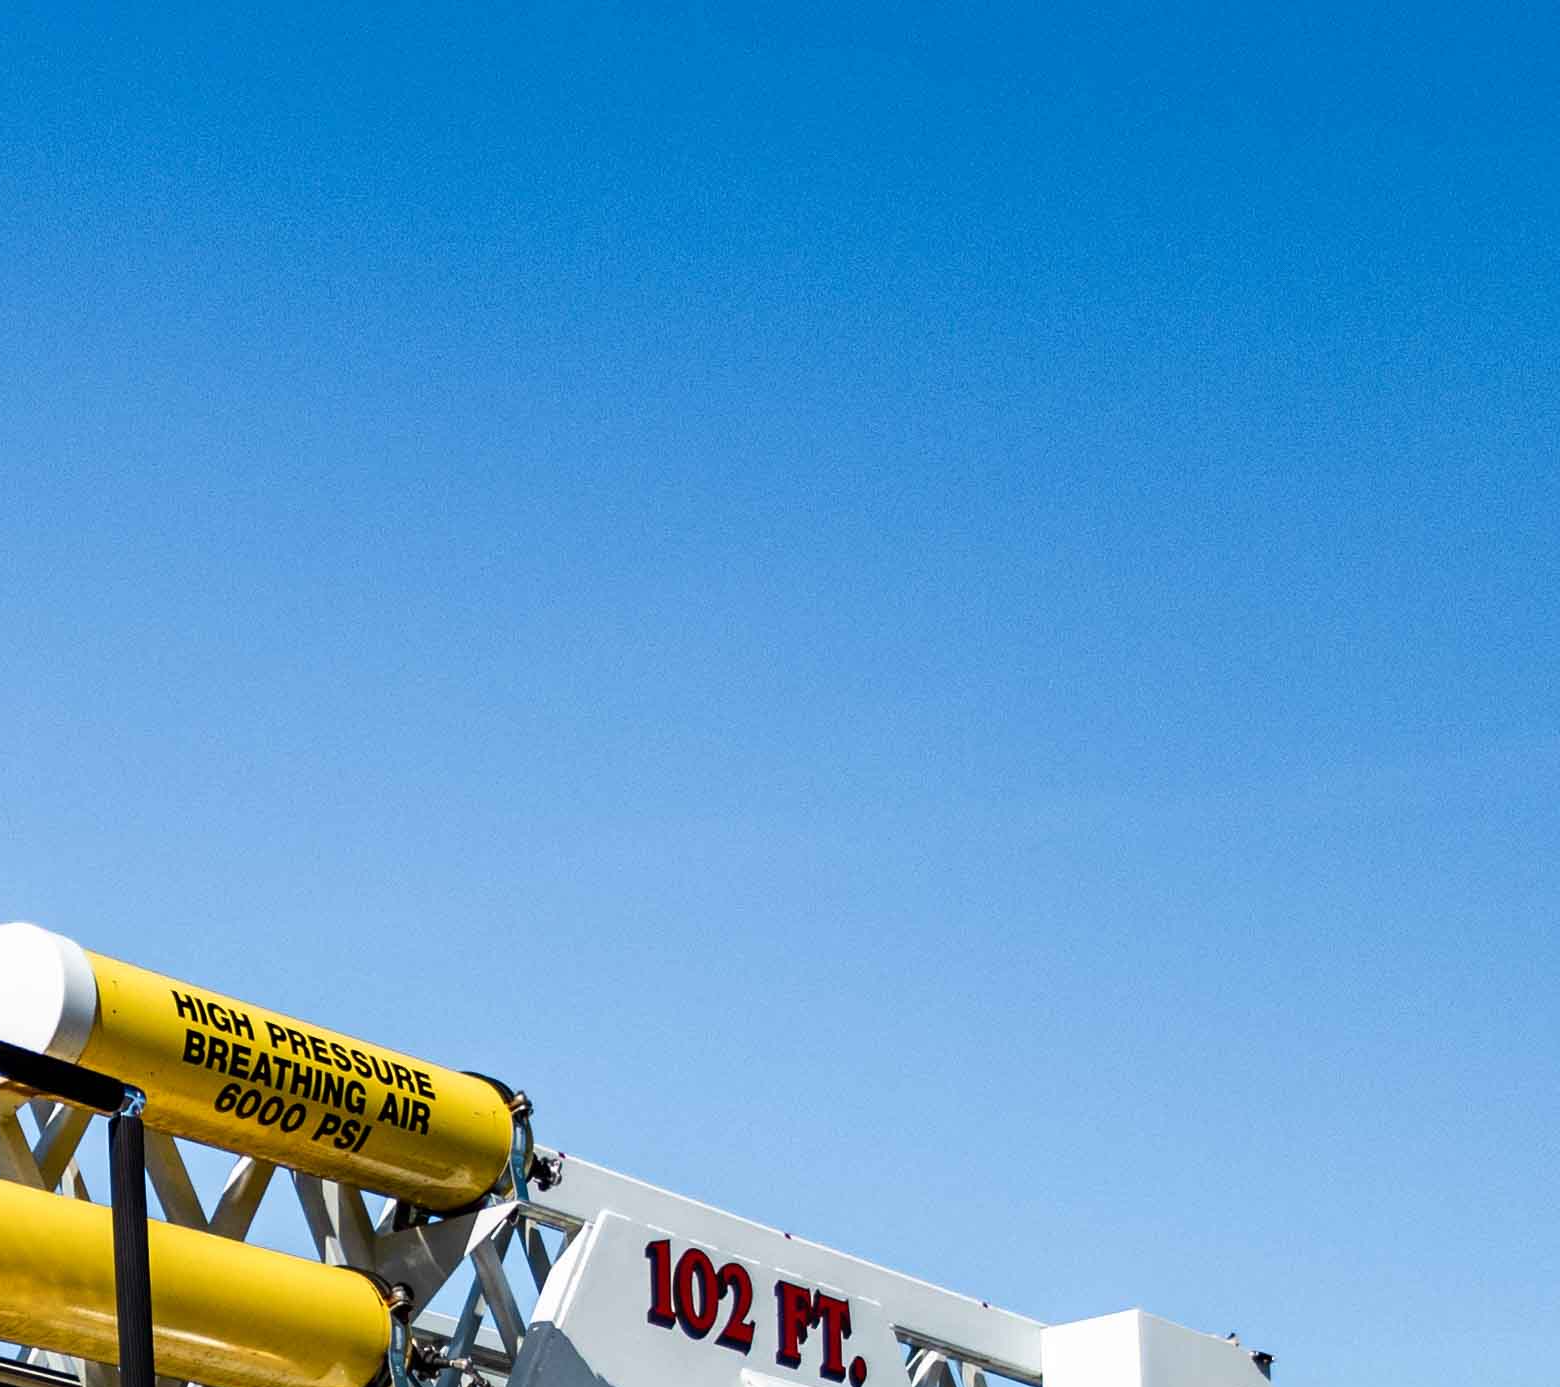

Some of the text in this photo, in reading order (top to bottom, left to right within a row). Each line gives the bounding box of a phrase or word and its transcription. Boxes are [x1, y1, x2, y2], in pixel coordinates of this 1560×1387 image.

[170, 990, 436, 1101] HIGH PRESSURE
[182, 1028, 431, 1136] BREATHING AIR
[214, 1082, 372, 1153] 6000 PSI
[644, 1238, 756, 1357] 102
